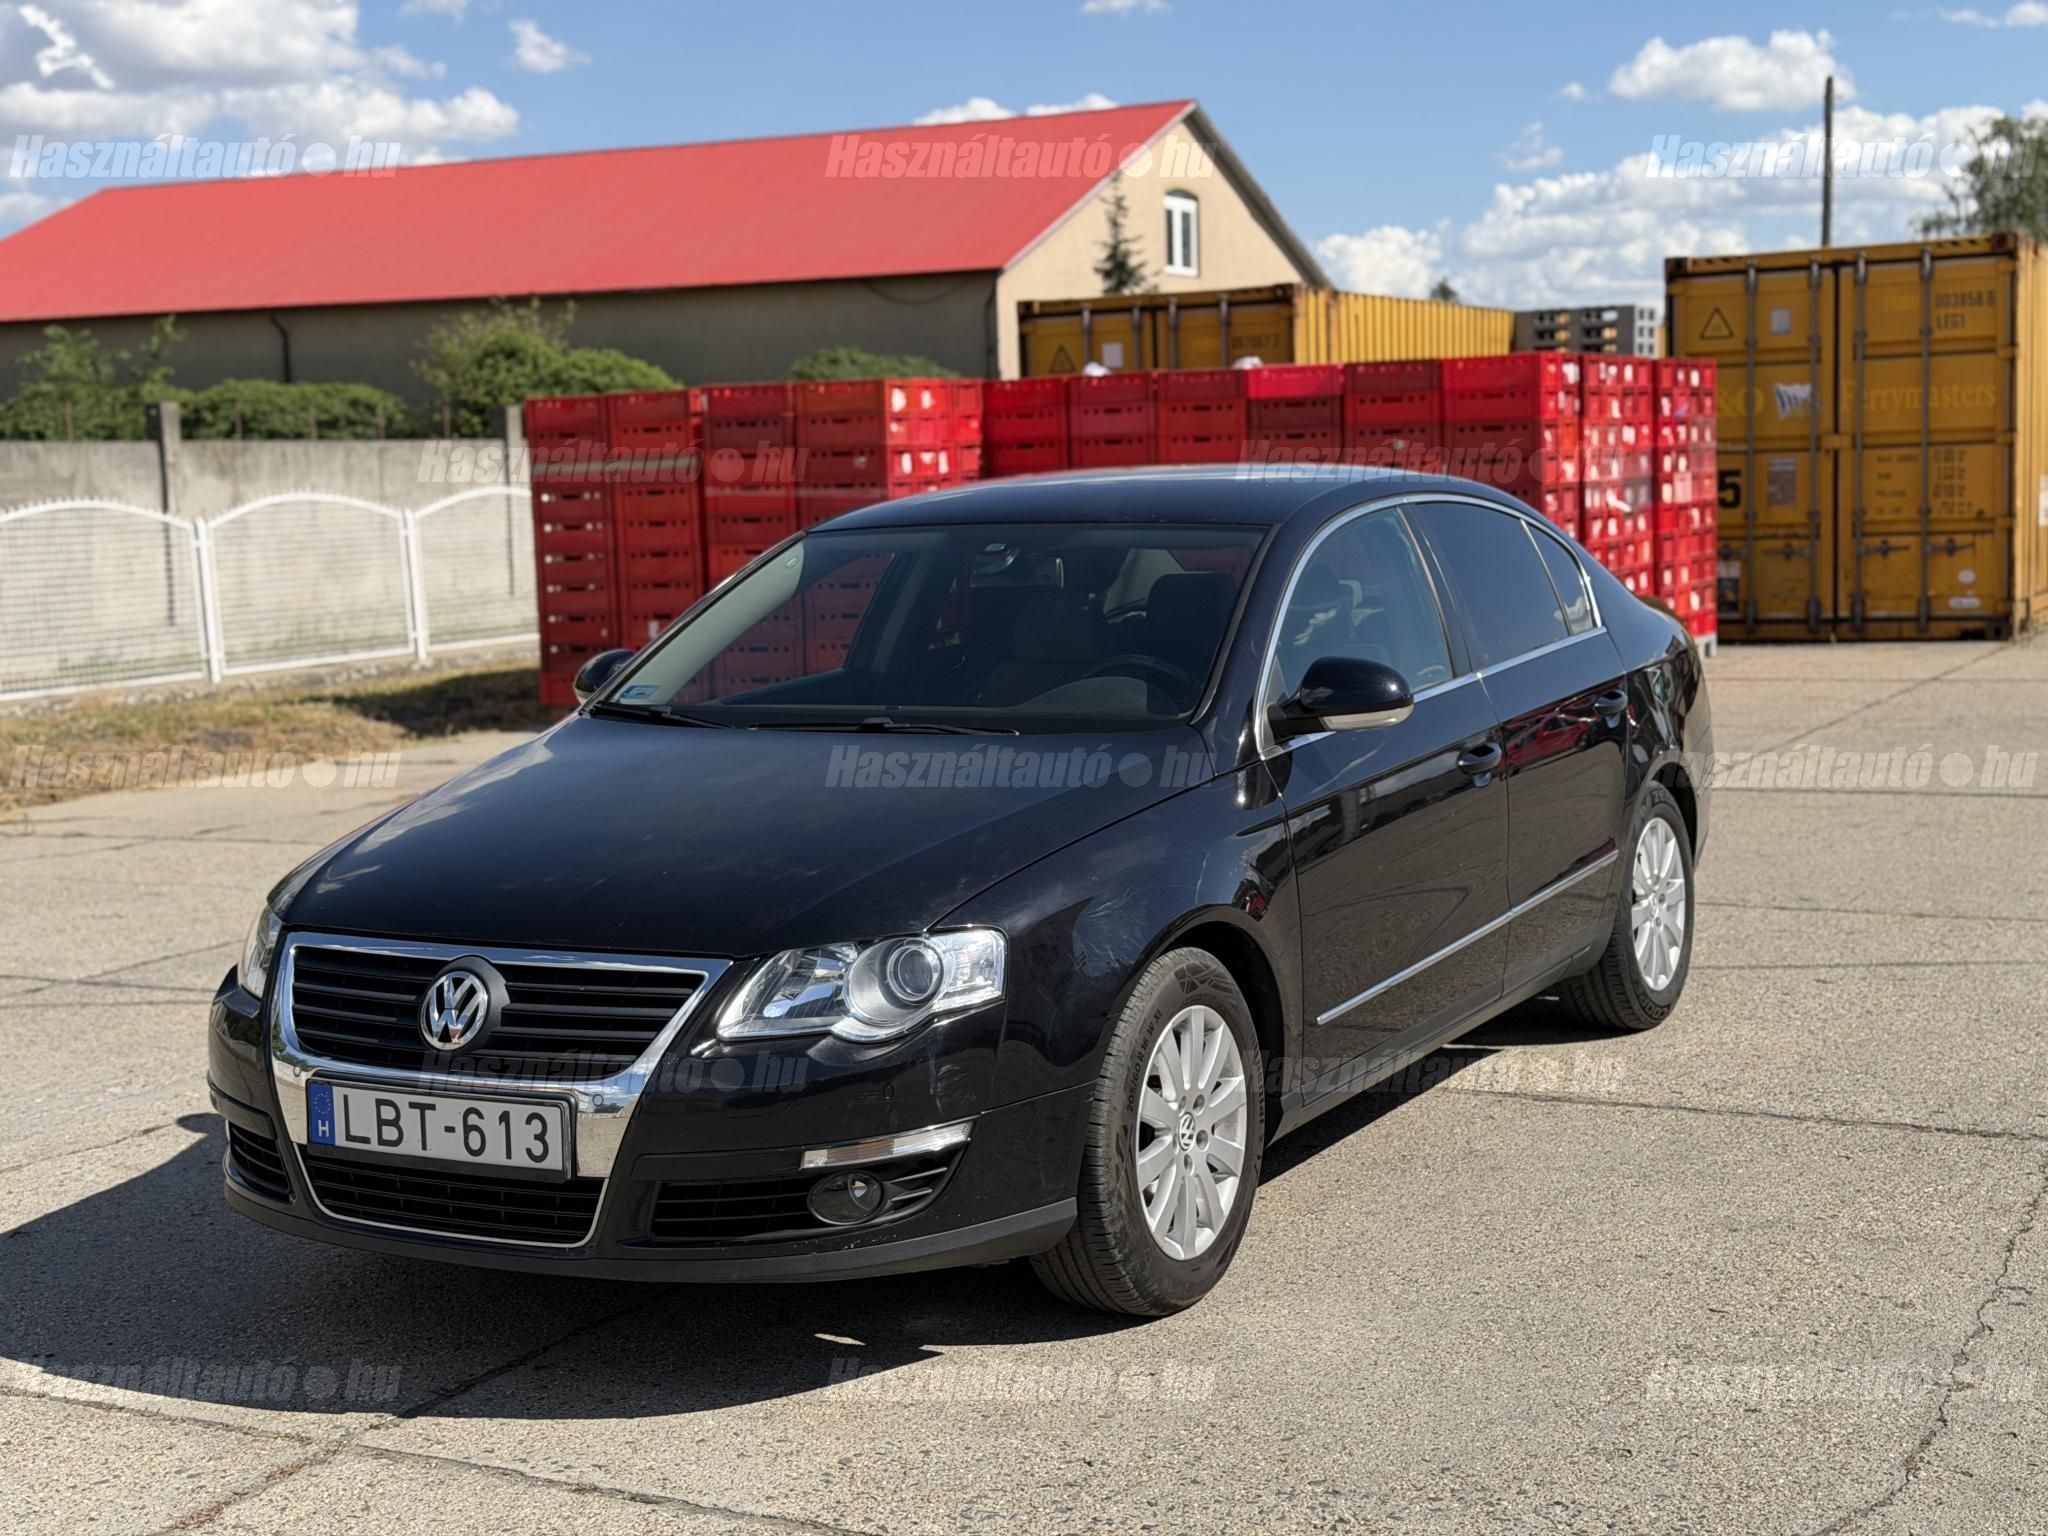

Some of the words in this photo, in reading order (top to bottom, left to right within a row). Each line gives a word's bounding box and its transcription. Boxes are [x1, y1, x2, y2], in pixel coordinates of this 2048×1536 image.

[1717, 386, 1764, 417] &O
[1841, 381, 1997, 416] Frrymasters
[317, 1119, 329, 1138] H
[343, 1094, 549, 1163] LBT-613
